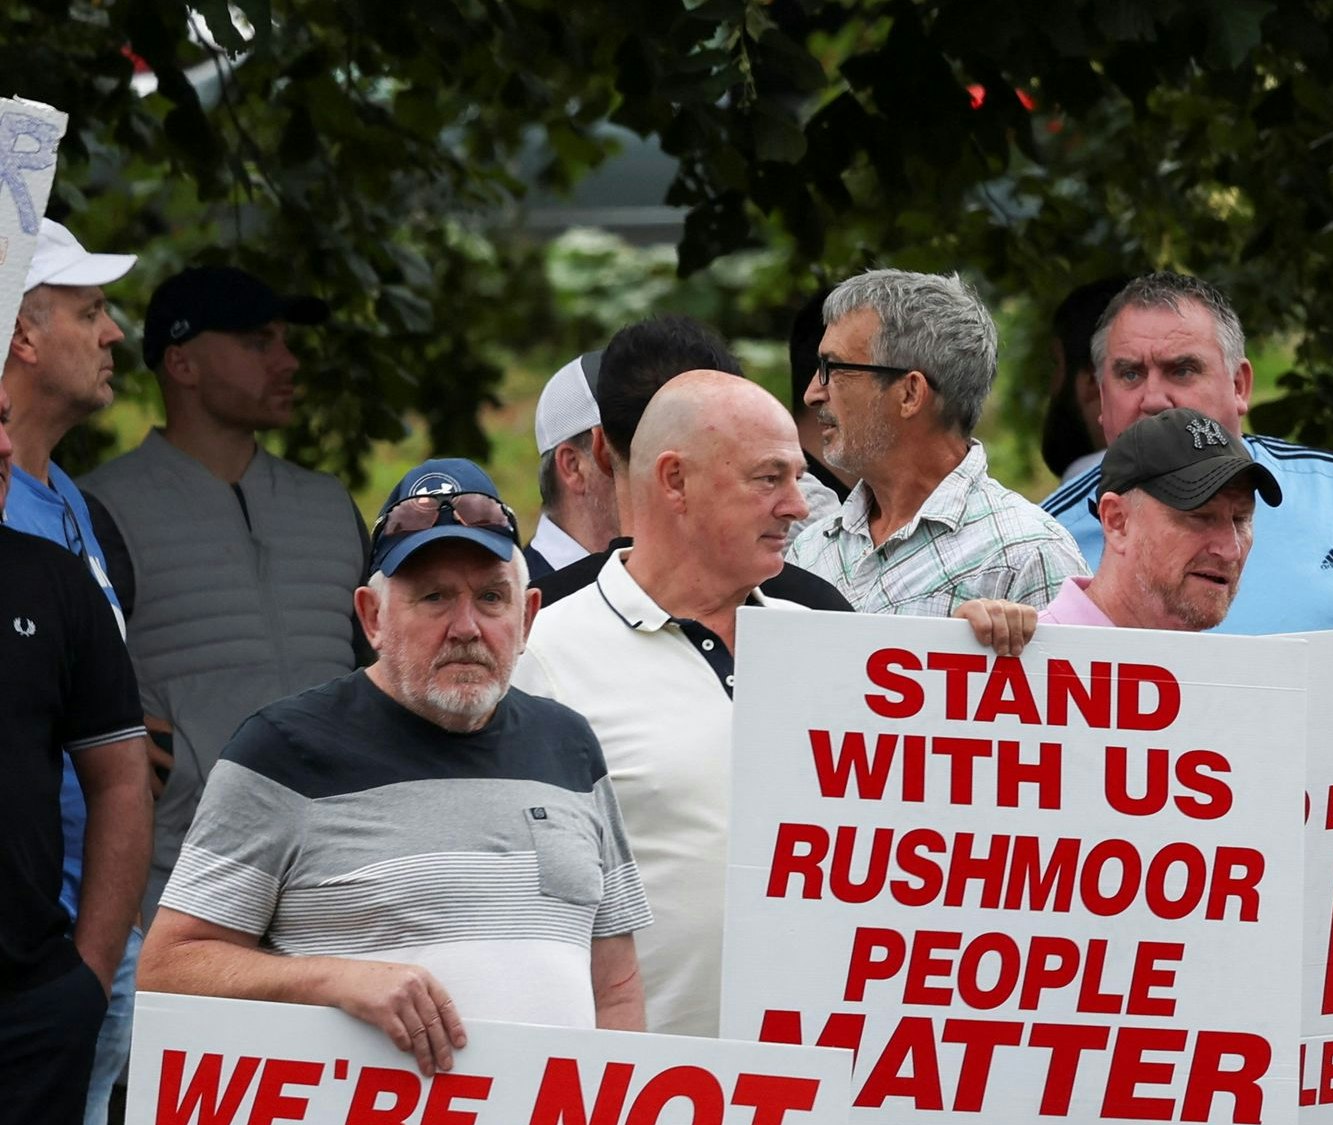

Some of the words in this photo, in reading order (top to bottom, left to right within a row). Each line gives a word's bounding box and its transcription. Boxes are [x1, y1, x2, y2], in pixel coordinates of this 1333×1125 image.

[864, 648, 1181, 731] STAND
[809, 729, 1062, 810] WITH
[1104, 746, 1233, 820] US
[766, 822, 1265, 922] RUSHMOOR
[843, 927, 1185, 1017] PEOPLE
